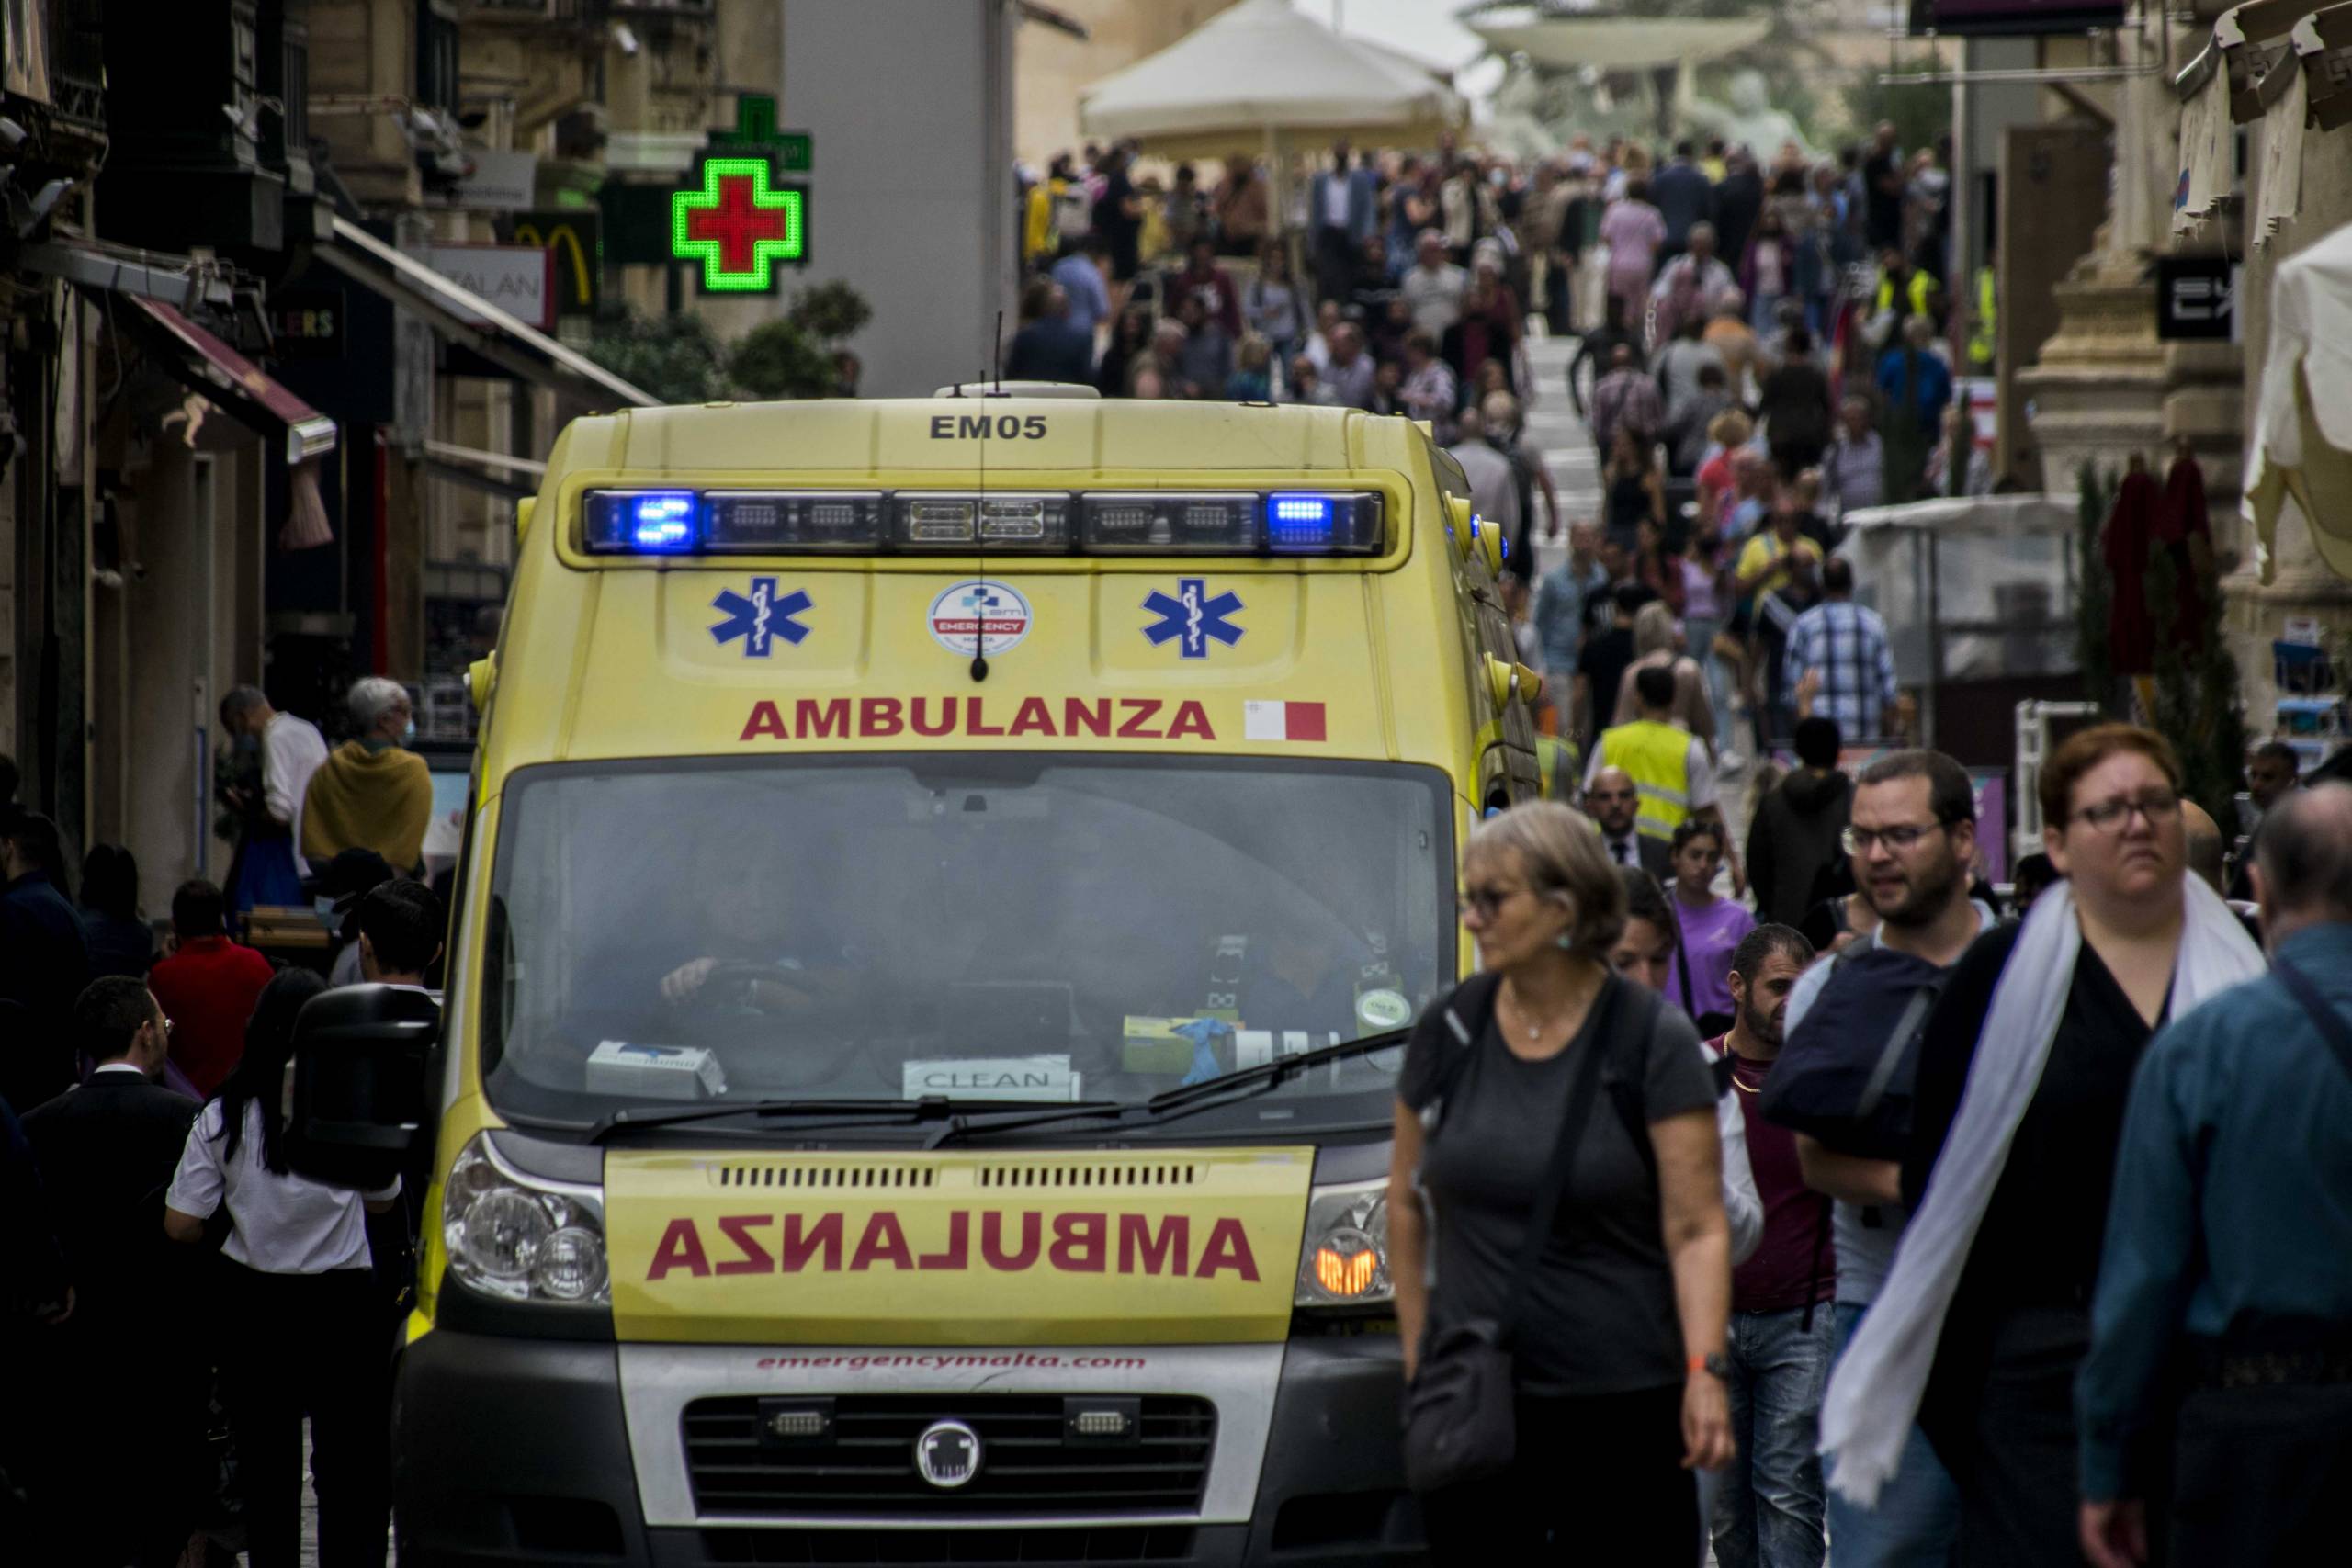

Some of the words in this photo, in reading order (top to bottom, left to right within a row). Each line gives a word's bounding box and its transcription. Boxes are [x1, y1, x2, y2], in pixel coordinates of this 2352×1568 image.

[930, 415, 1047, 440] EM05
[740, 697, 1216, 741] AMBULANZA
[924, 1073, 1049, 1088] CLEAN
[757, 1352, 1147, 1371] emergencymalta.com
